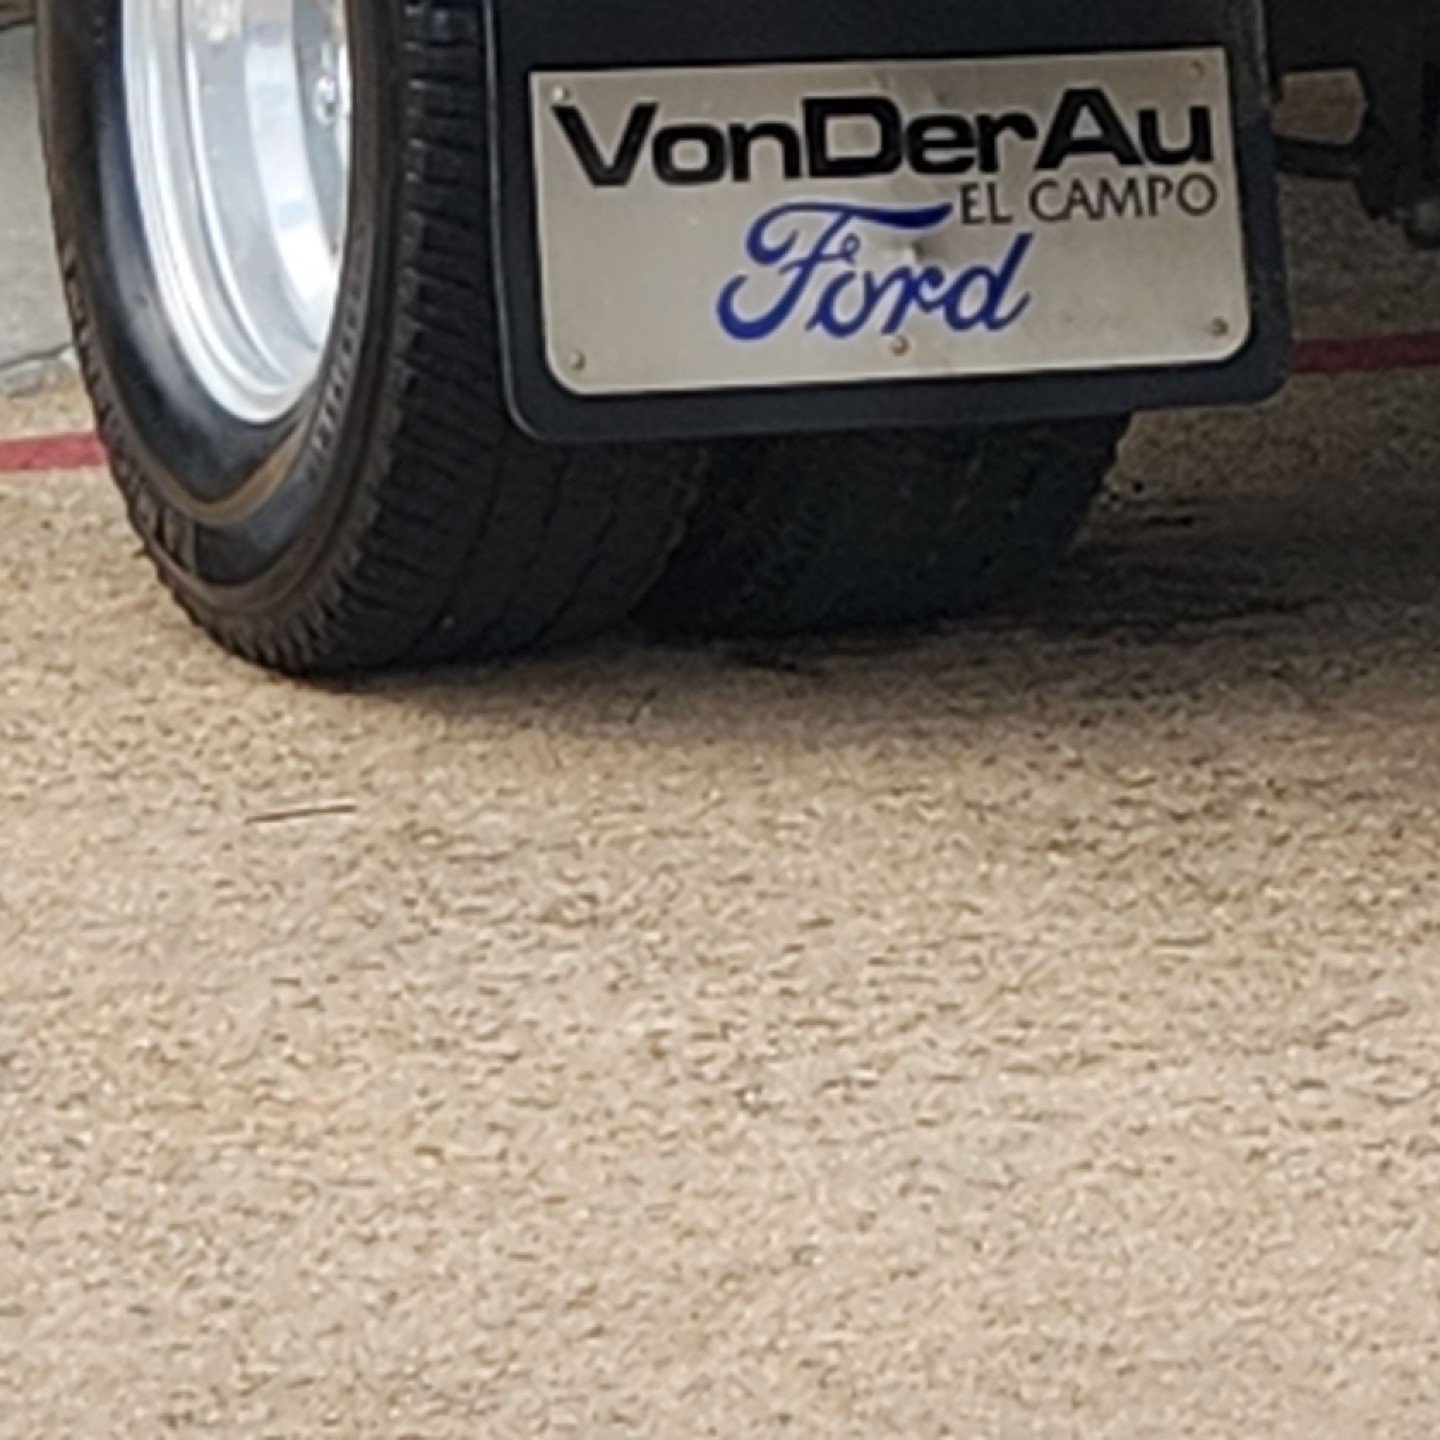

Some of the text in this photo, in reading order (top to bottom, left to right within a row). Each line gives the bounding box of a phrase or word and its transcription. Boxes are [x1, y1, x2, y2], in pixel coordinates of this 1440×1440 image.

[550, 86, 1214, 188] VonDerAu
[959, 171, 1219, 226] EL CAMPO
[715, 200, 1034, 342] Ford
